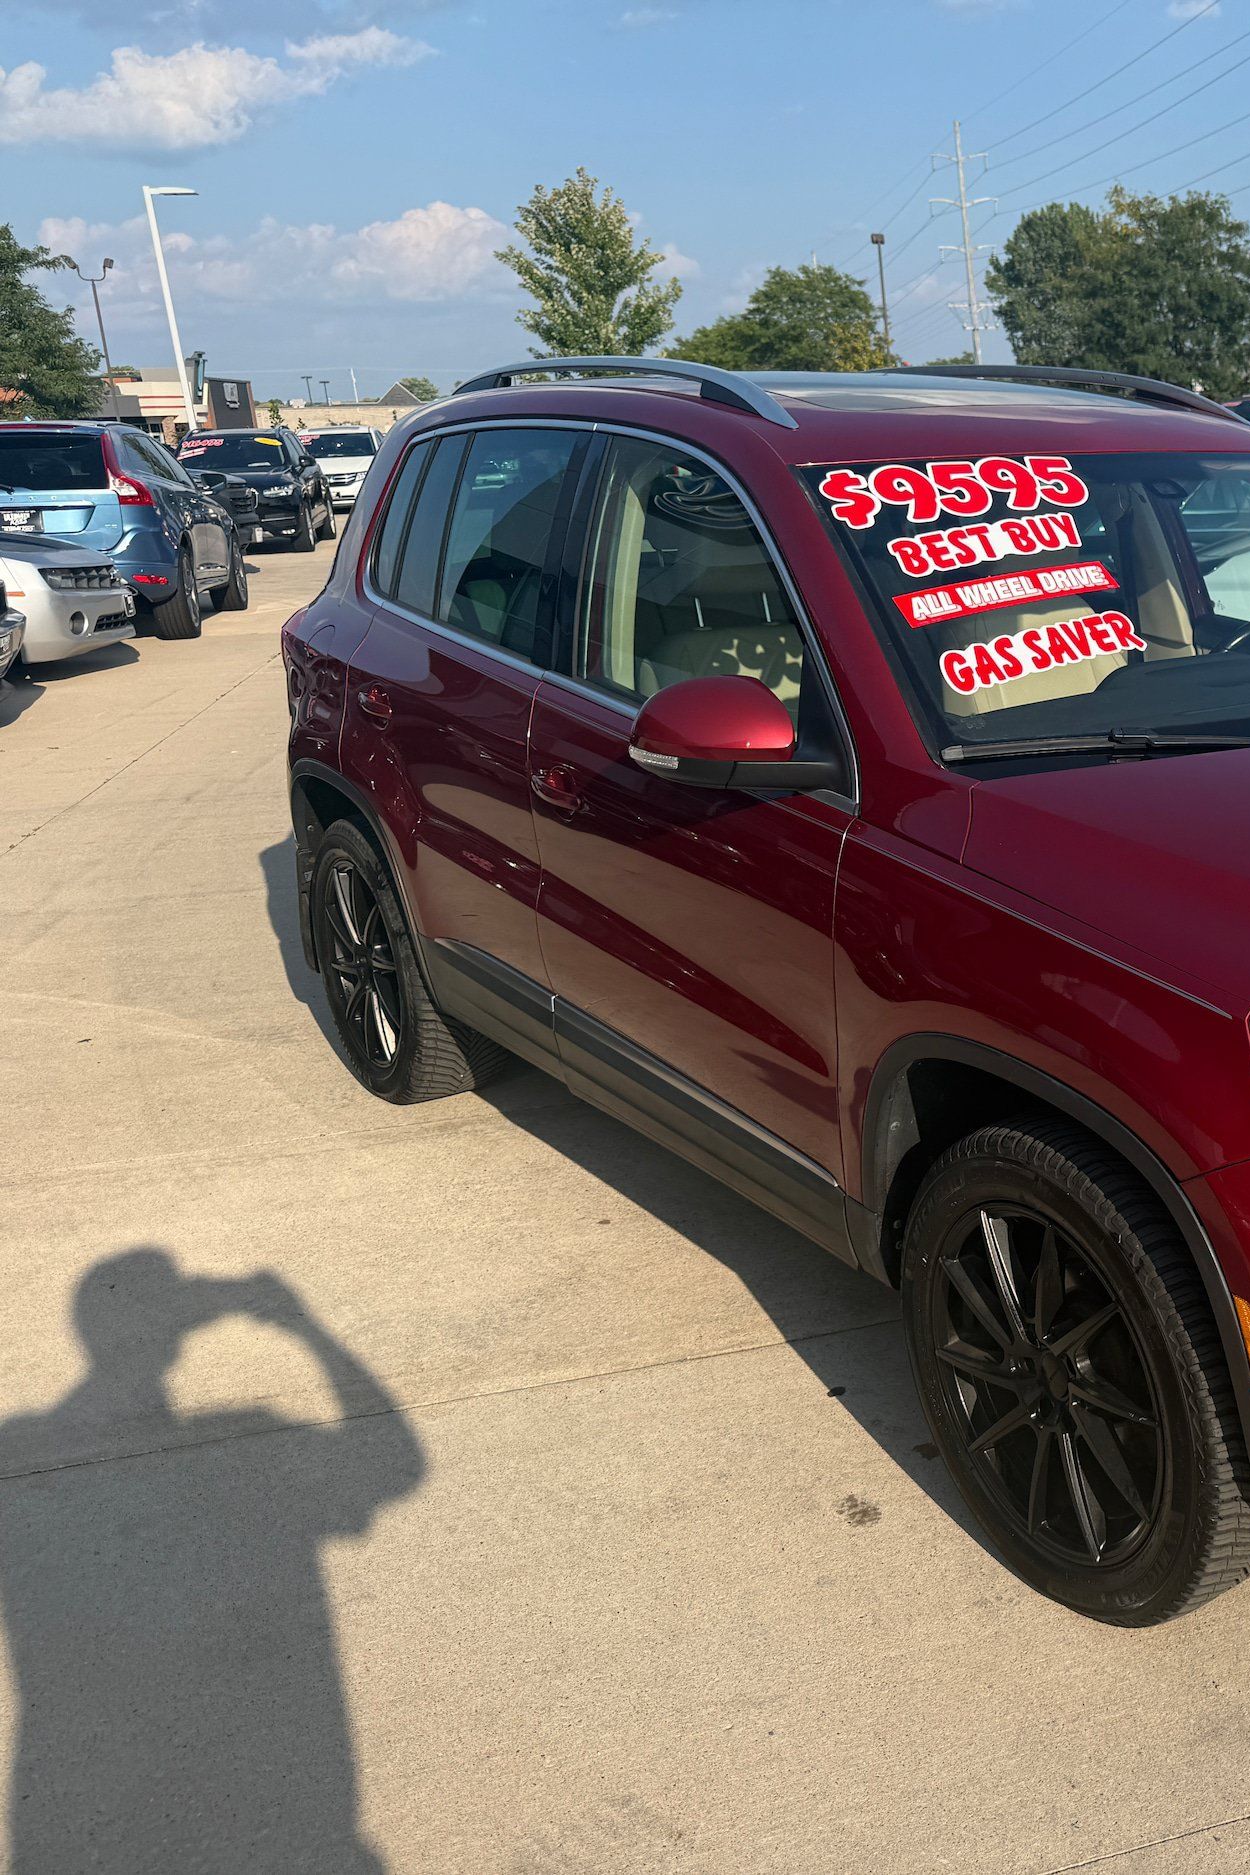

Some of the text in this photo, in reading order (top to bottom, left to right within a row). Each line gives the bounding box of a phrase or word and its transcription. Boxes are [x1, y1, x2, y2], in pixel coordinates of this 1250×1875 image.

[821, 458, 1087, 528] $9595
[891, 514, 1079, 575] BEST BUY
[911, 565, 1109, 621] ALL WHEEL DRIVE
[943, 612, 1144, 692] GAS SAVER
